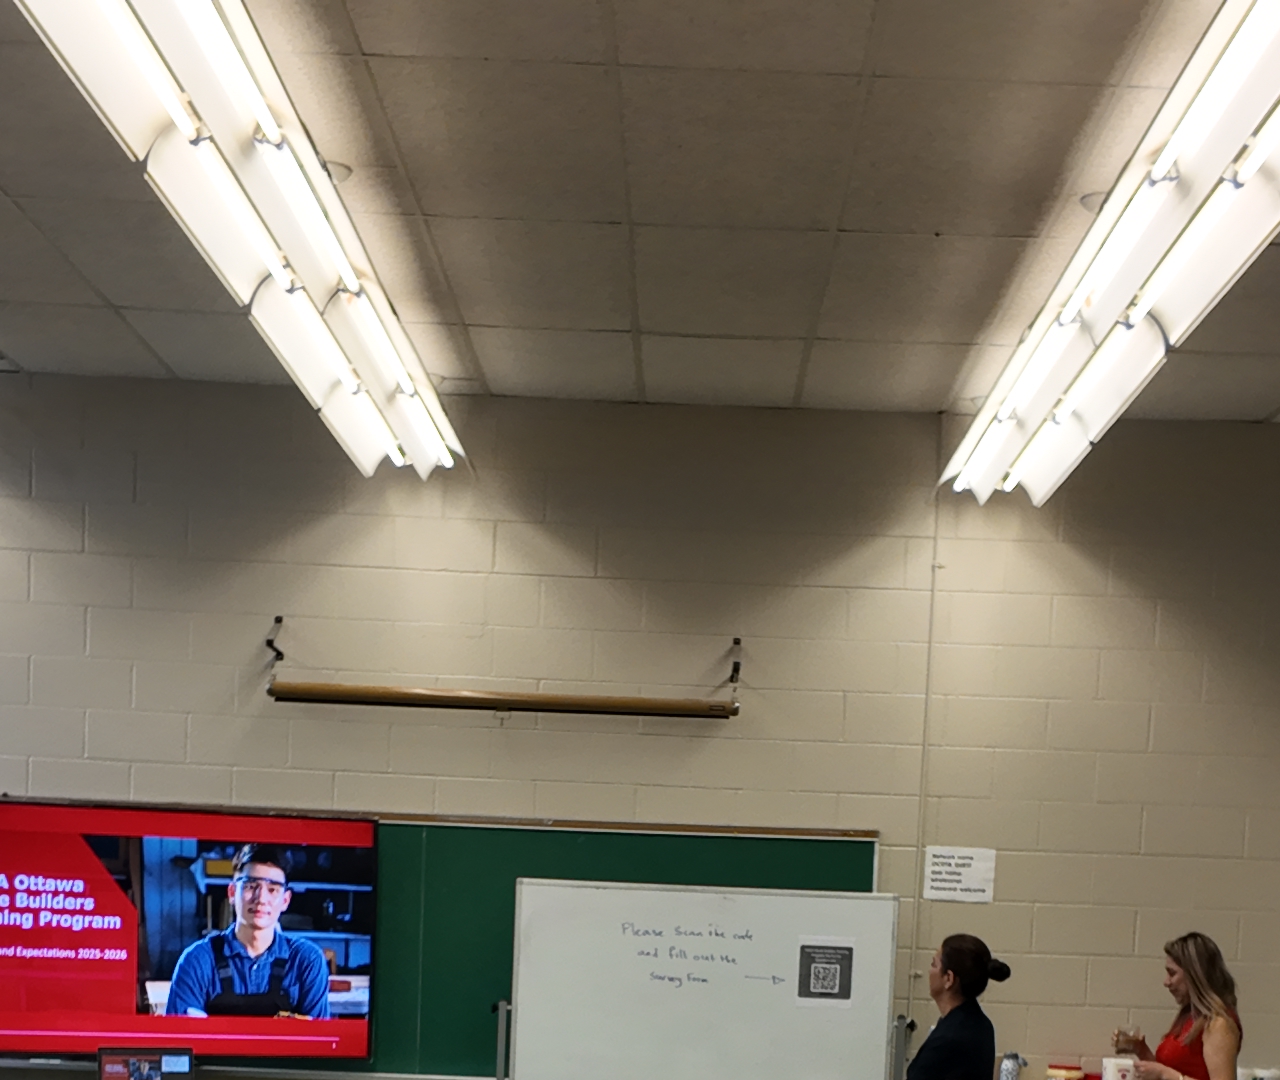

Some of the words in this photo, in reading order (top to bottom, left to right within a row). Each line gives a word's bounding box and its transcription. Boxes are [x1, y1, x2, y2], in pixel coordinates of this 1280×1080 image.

[14, 874, 85, 893] Ottawa
[15, 892, 95, 911] Builders
[39, 911, 122, 931] Program
[621, 922, 664, 937] Please
[16, 946, 76, 959] Expectations
[77, 948, 128, 960] 2025-2026
[637, 947, 659, 958] and
[693, 954, 716, 962] out
[720, 954, 738, 965] the
